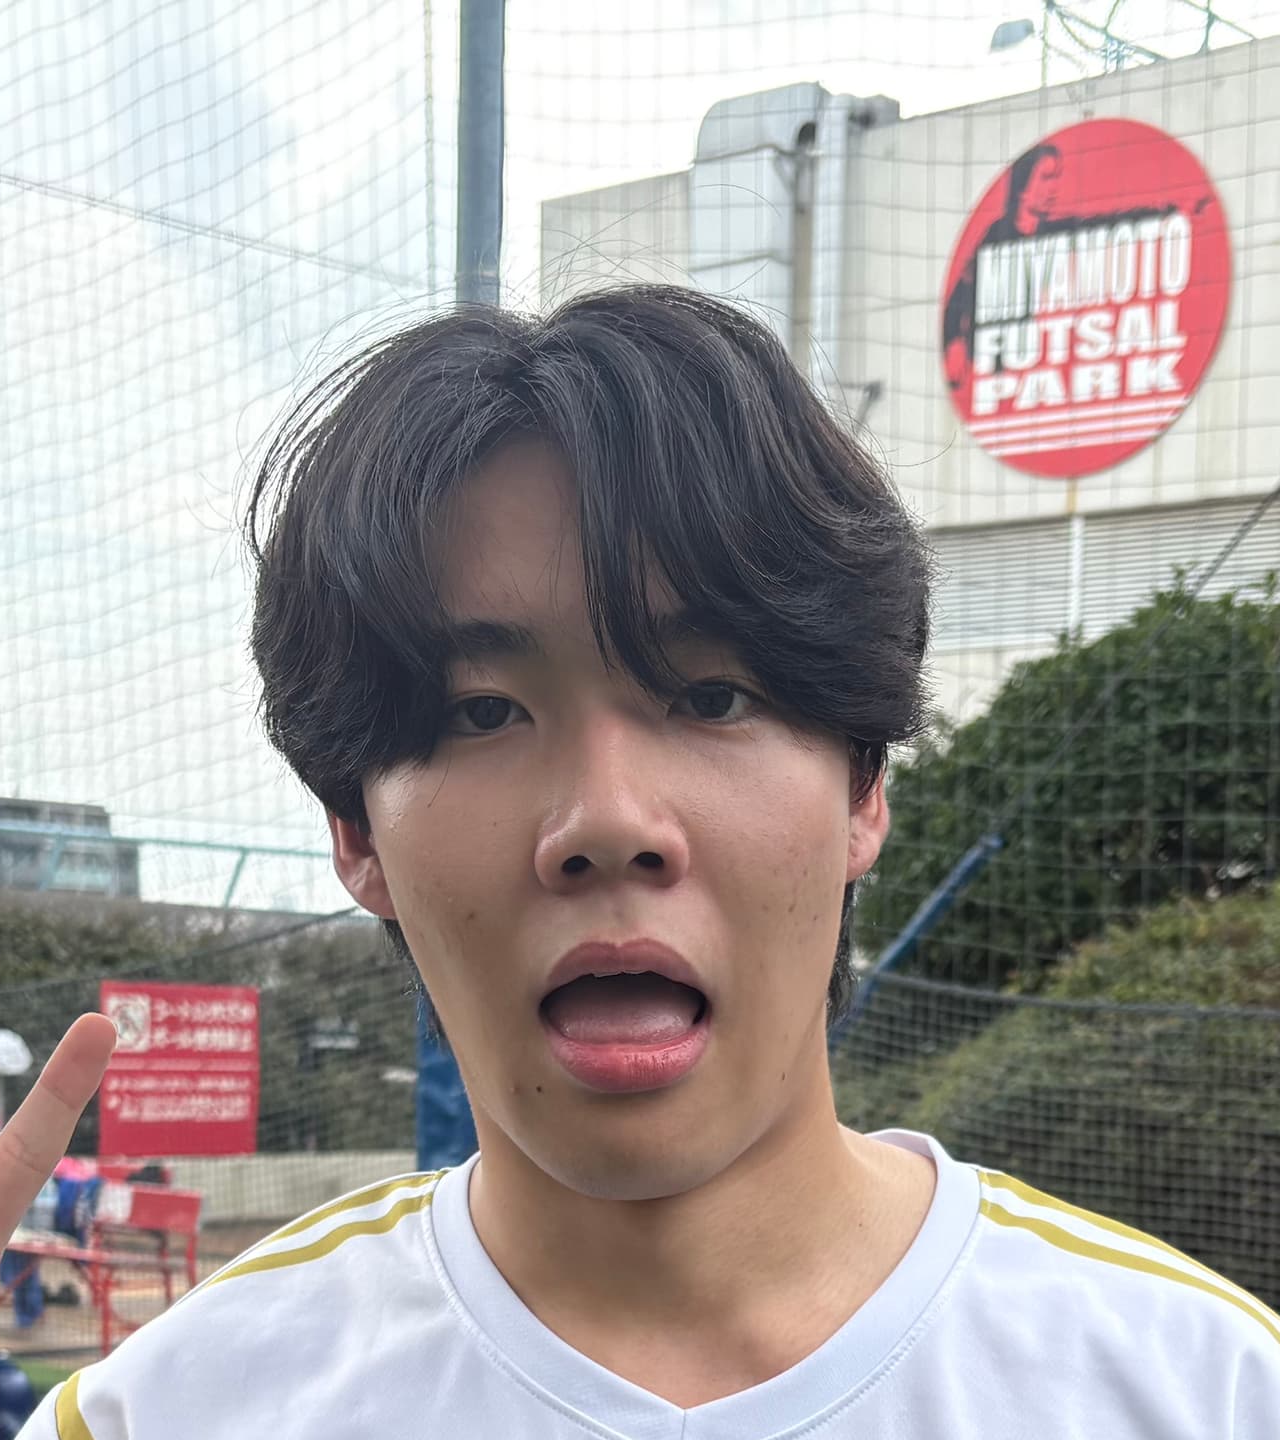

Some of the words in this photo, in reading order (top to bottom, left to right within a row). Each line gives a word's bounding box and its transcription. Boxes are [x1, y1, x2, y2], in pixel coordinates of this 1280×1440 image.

[975, 214, 1193, 325] MIYAMOTO
[973, 300, 1187, 374] FUTSAL
[970, 353, 1184, 416] PARK
